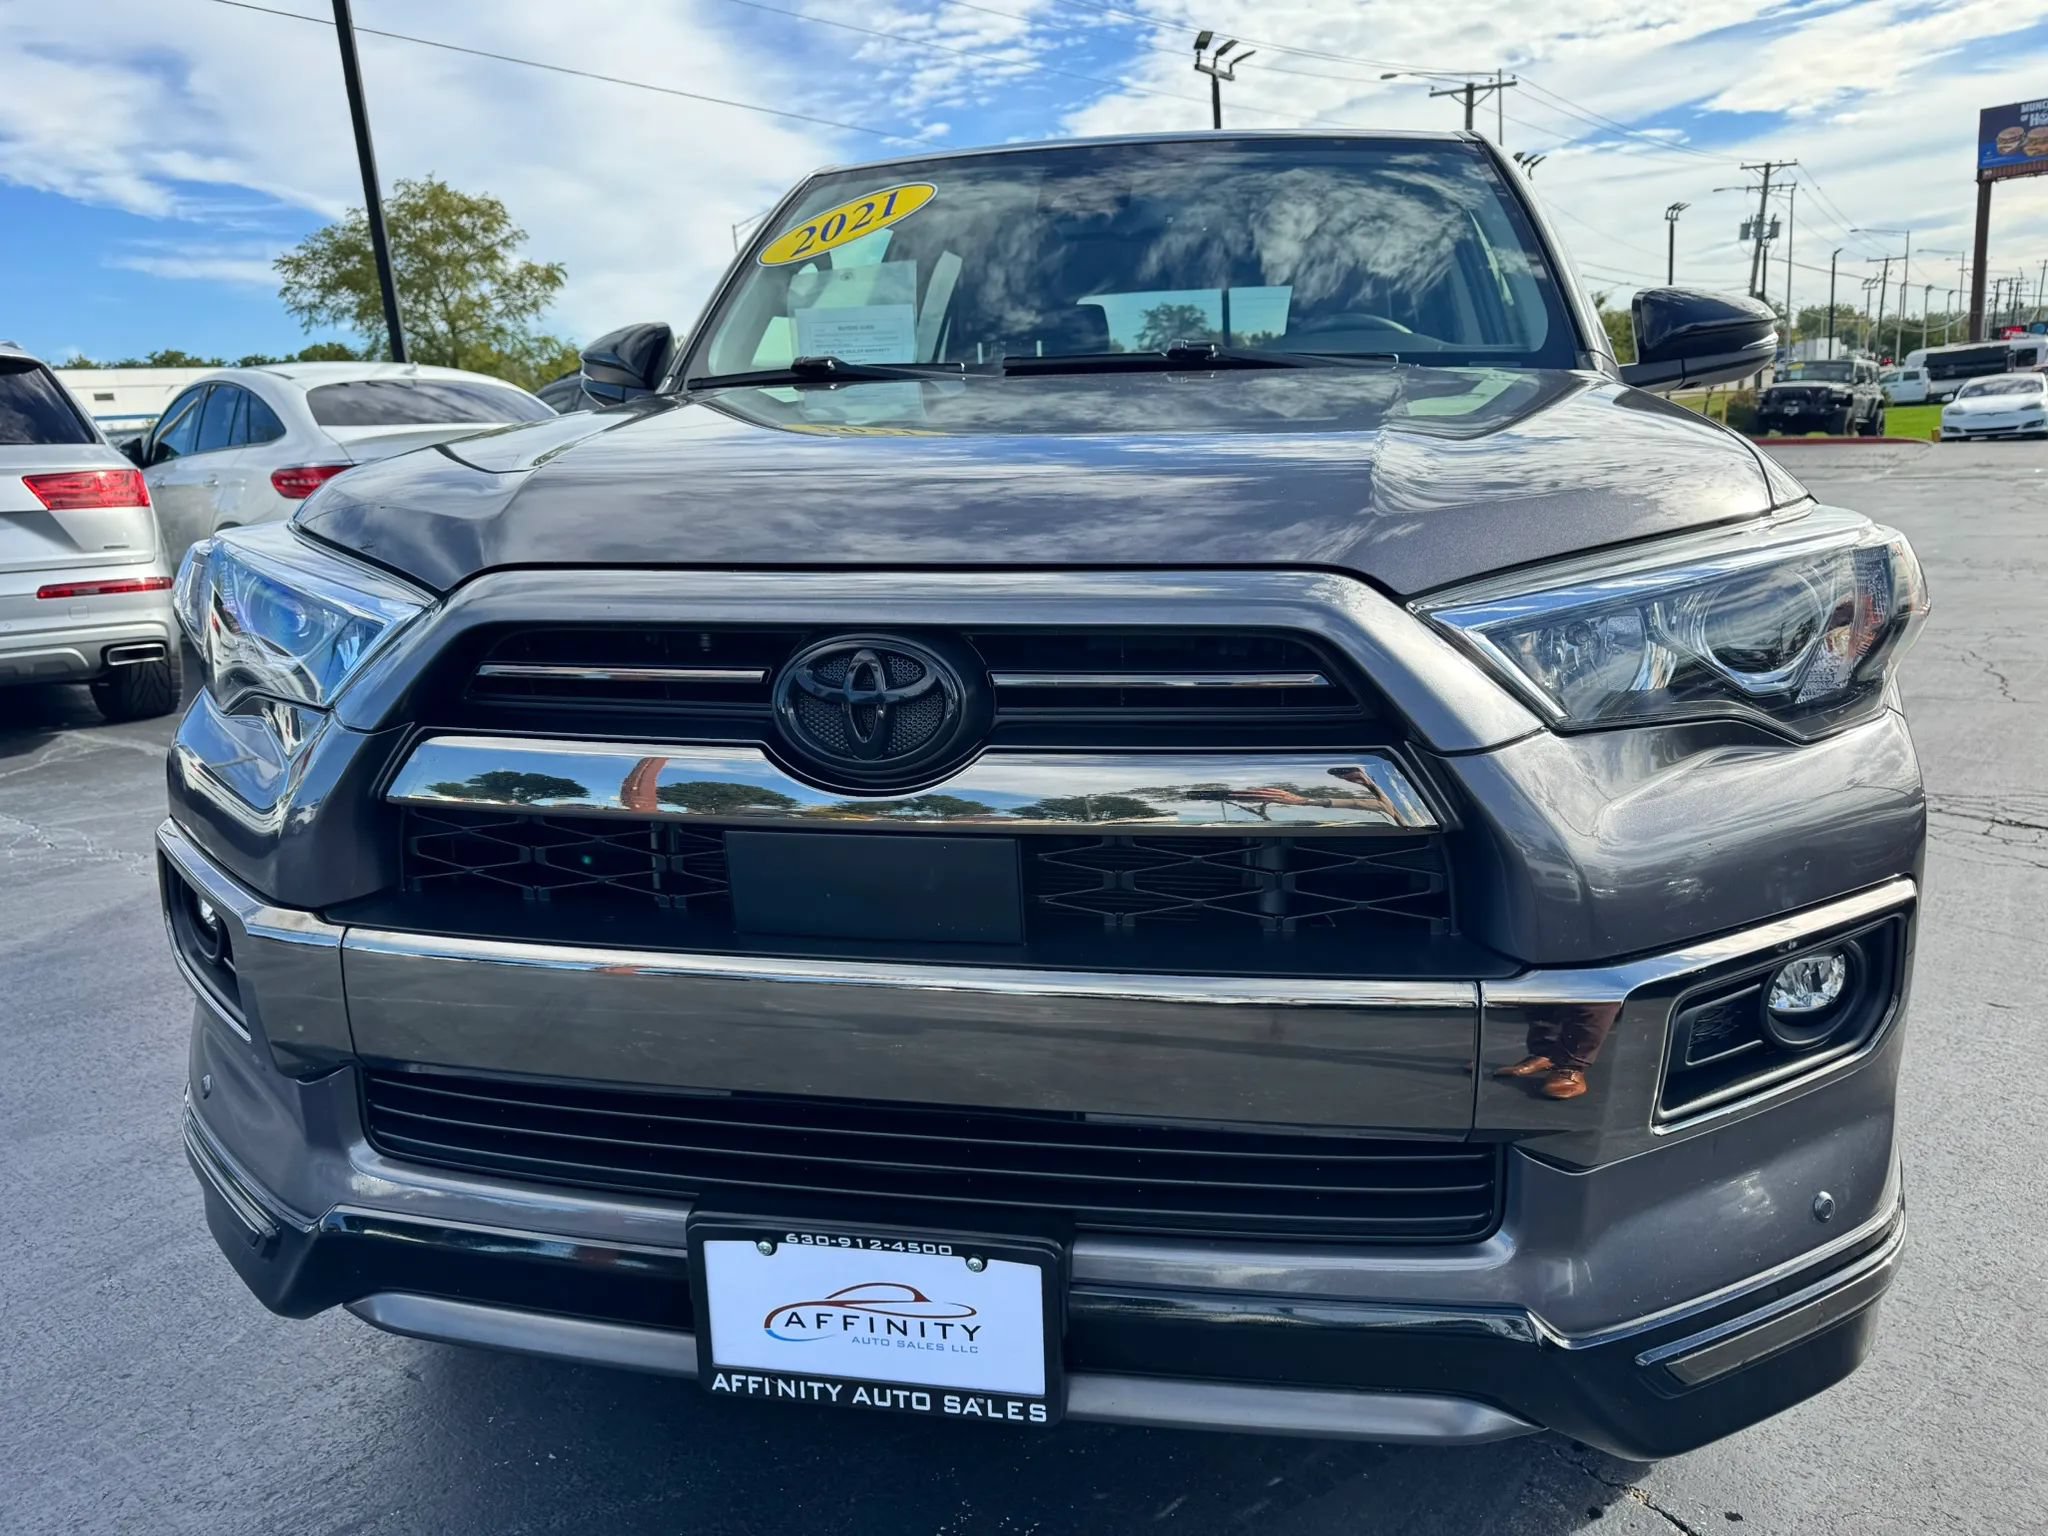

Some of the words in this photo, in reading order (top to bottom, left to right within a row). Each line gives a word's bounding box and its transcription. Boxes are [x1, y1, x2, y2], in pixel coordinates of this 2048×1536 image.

[789, 190, 899, 258] 2021
[785, 1232, 953, 1256] 630-912-4500
[784, 1311, 982, 1342] AFFINITY
[851, 1336, 890, 1347] AUTO
[896, 1340, 945, 1352] SALES
[950, 1344, 979, 1354] LLC
[711, 1373, 843, 1402] AFFINITY
[851, 1386, 931, 1411] AUTO
[943, 1395, 1047, 1423] SALES
